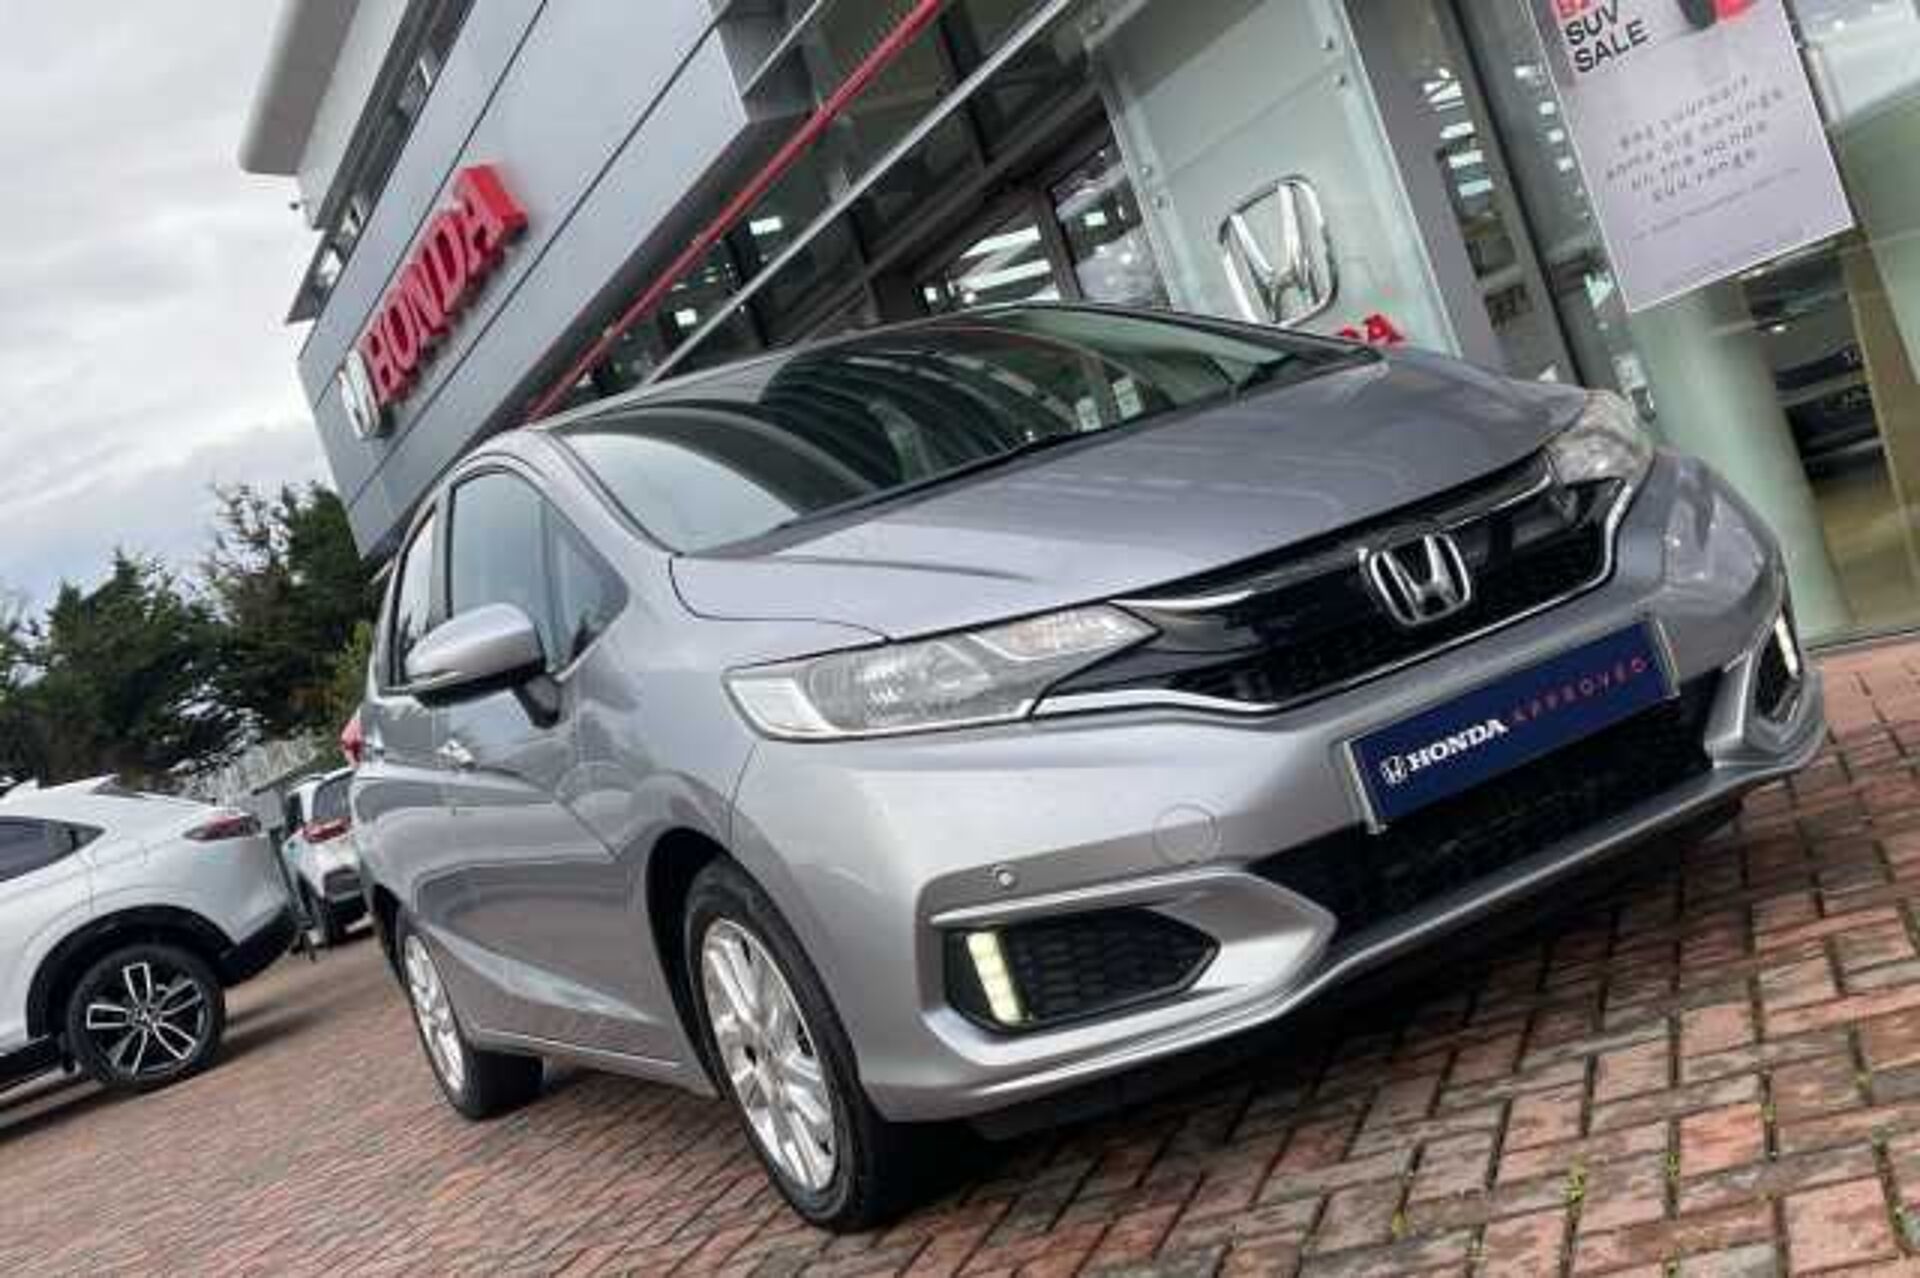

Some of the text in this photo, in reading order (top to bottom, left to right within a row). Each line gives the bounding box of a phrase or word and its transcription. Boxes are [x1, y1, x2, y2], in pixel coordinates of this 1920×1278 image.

[1565, 0, 1618, 45] SUV
[1574, 20, 1648, 73] SALE
[357, 164, 528, 406] HONDA
[1409, 719, 1509, 772] HONDA
